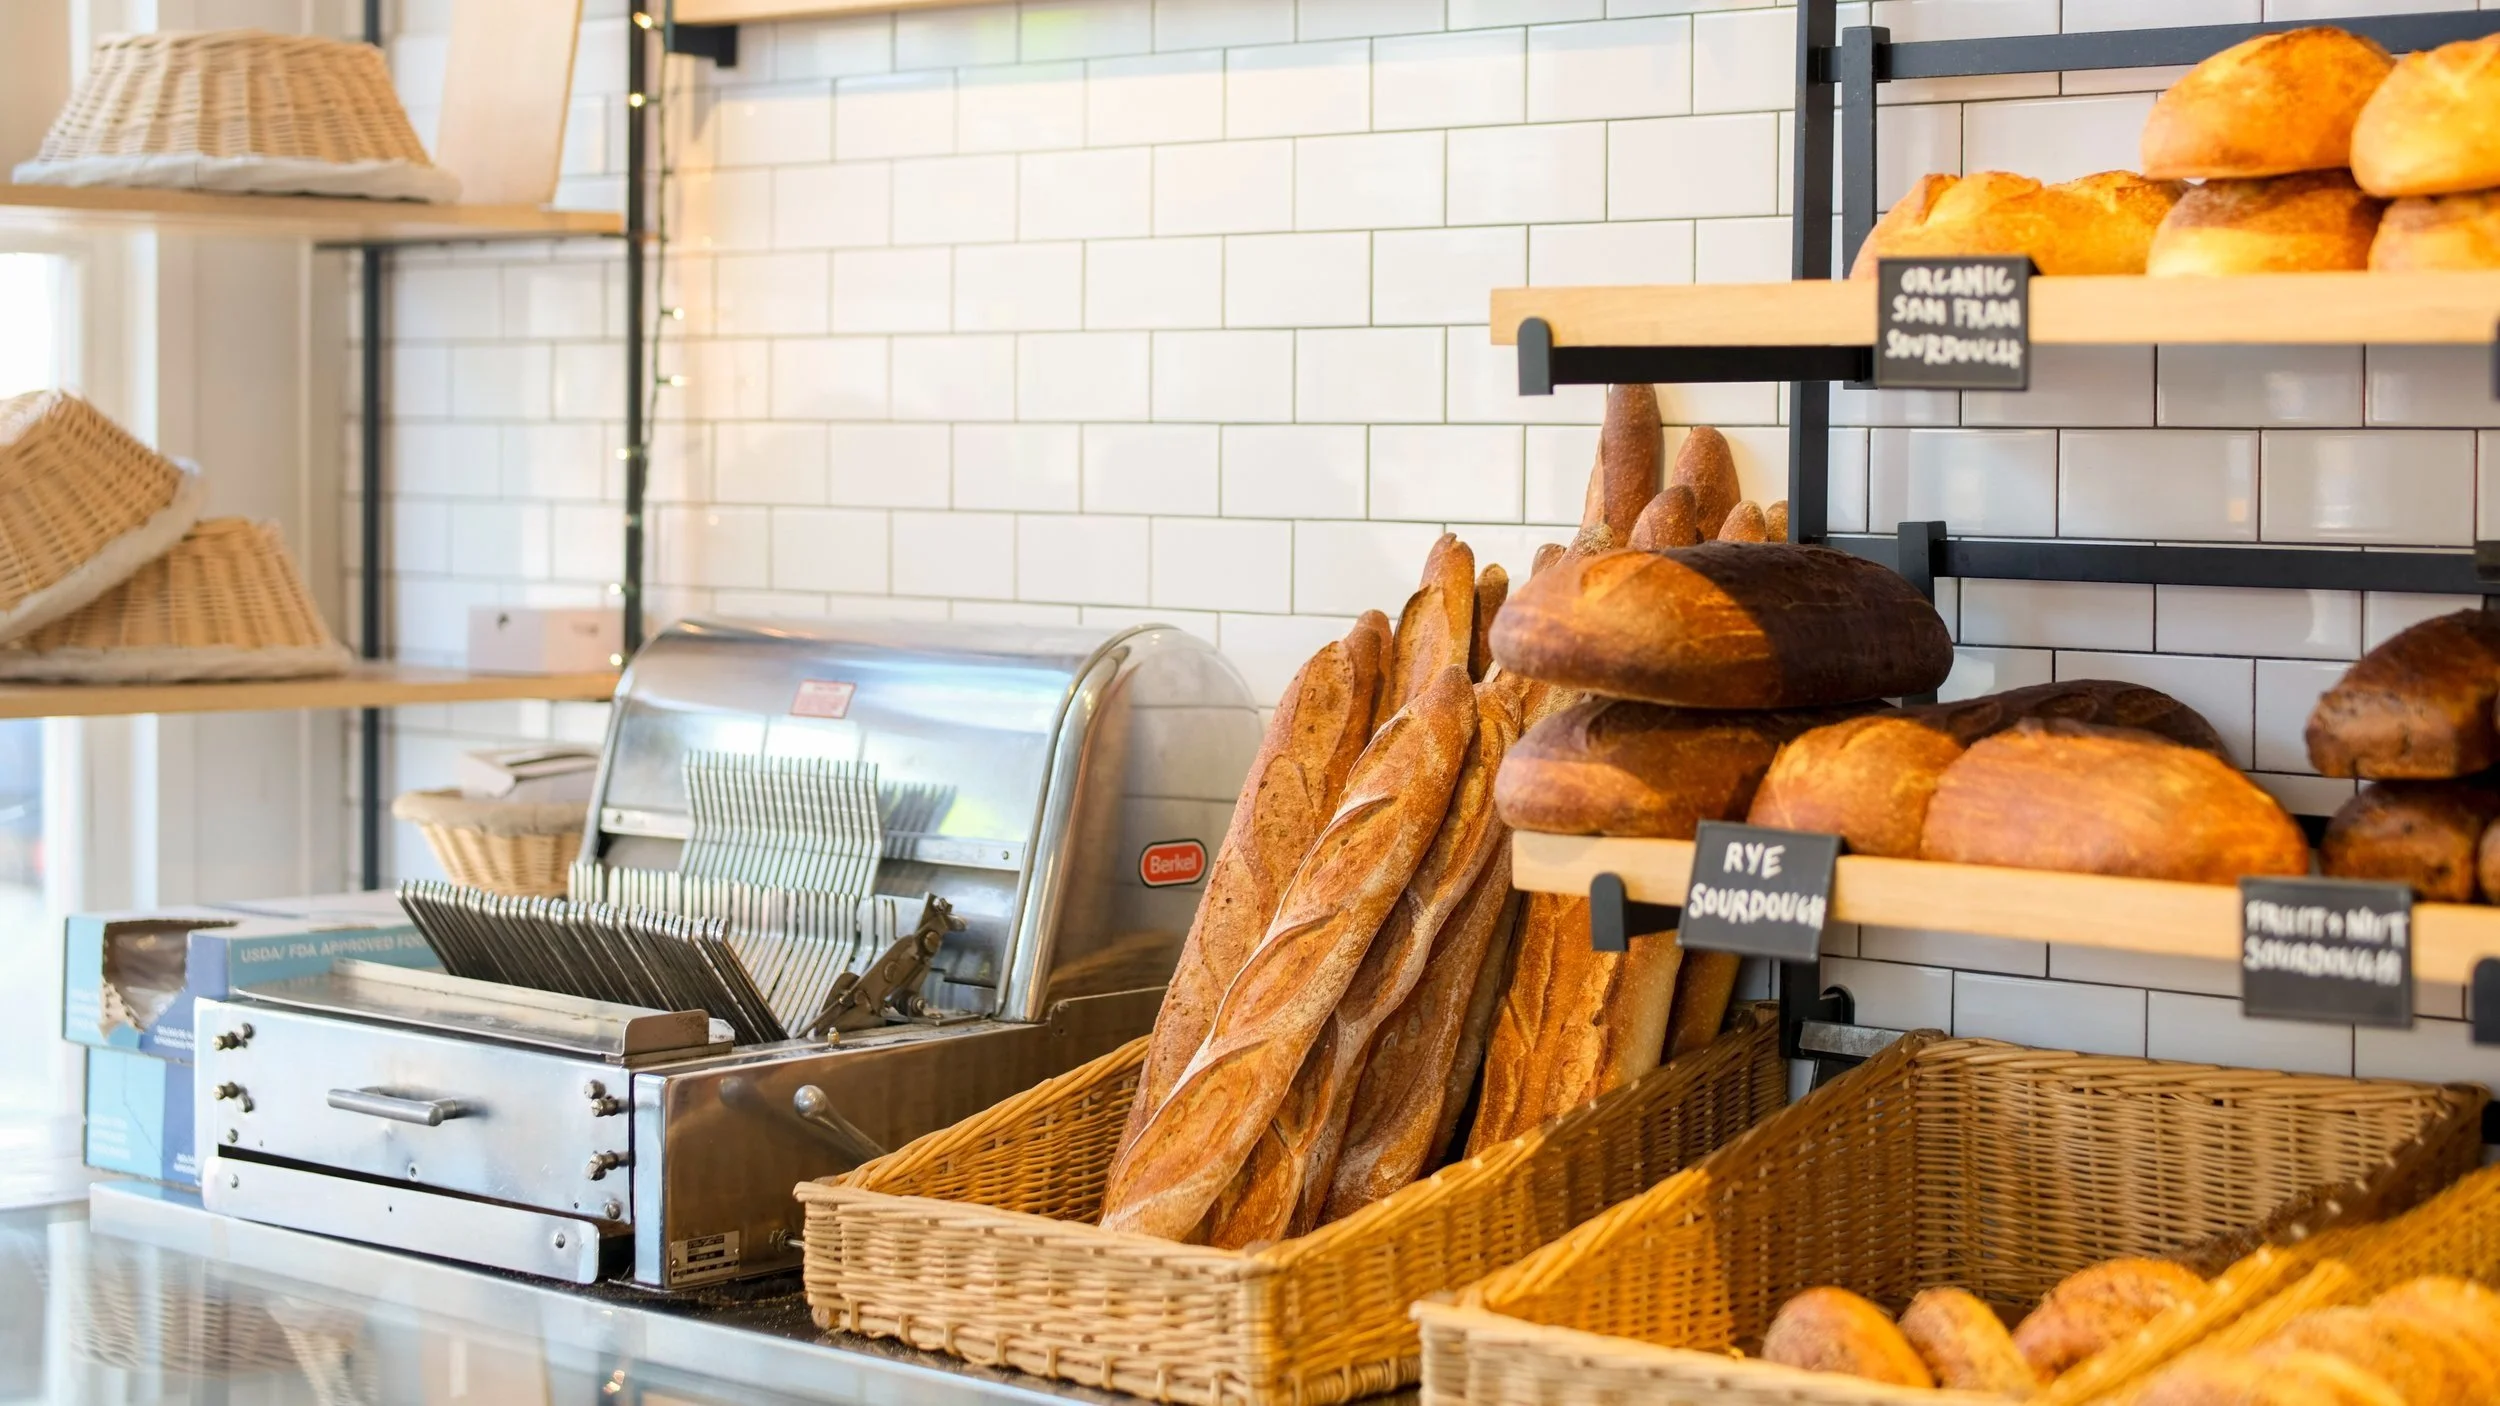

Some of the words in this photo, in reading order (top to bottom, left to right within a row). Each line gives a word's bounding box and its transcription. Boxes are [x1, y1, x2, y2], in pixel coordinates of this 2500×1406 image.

[1900, 264, 2016, 297] ORGANIC
[1891, 293, 1946, 326] SAN
[1952, 297, 2021, 330] FRAN
[1885, 328, 2023, 369] SOURDOUGH
[1150, 851, 1197, 875] Berkel
[1723, 841, 1786, 879] RYE
[1688, 882, 1826, 931] SOURDOUGH
[2245, 899, 2329, 940] FRUIT
[2345, 906, 2409, 948] NUT
[289, 942, 317, 958] FDA
[320, 935, 393, 956] APPROVED
[2243, 935, 2402, 987] SOURDOUGH
